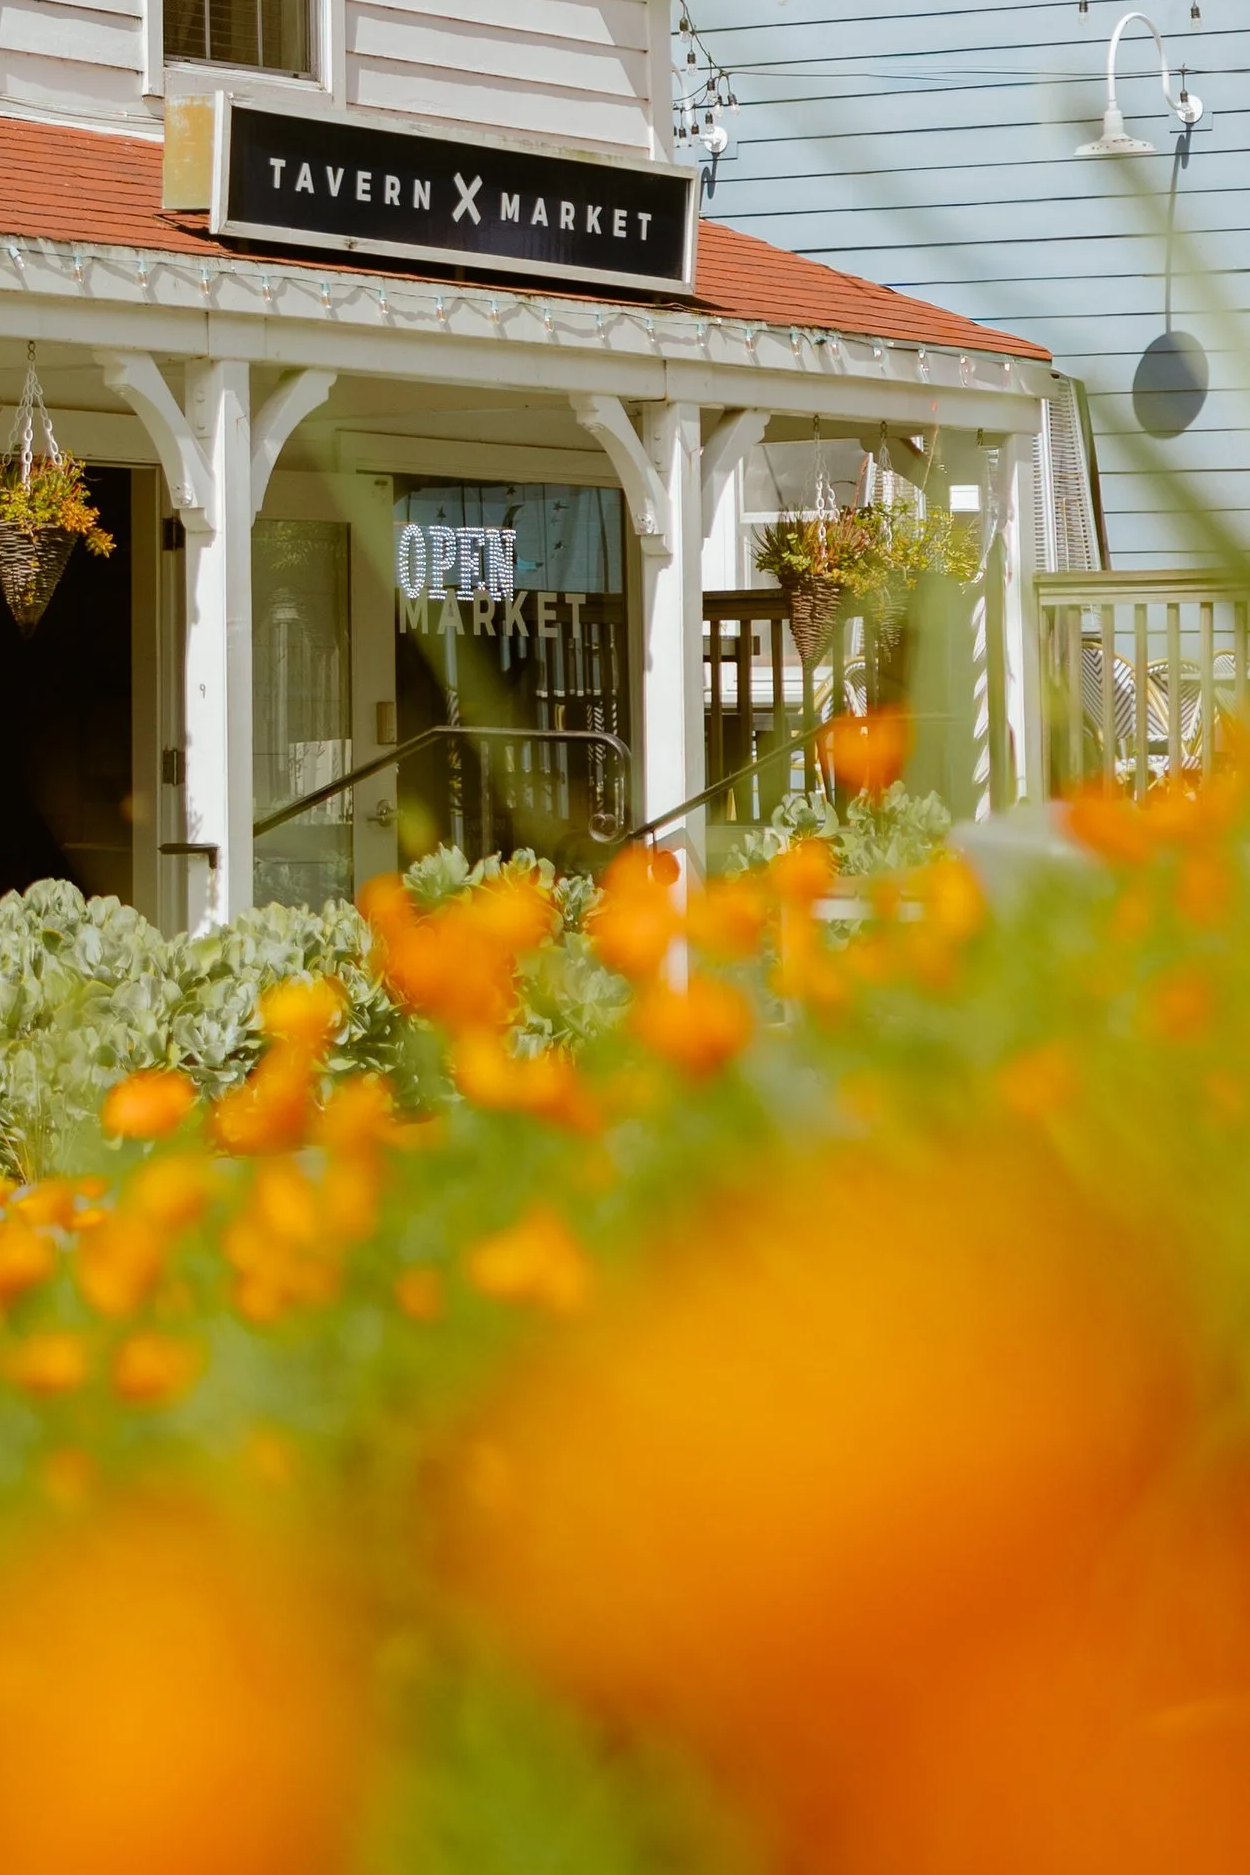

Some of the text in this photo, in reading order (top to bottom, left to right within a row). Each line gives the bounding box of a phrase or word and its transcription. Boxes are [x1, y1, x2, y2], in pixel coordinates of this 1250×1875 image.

[269, 157, 653, 242] TAVERN X MARKET
[398, 524, 517, 602] OPEN
[399, 588, 587, 640] MARKET
